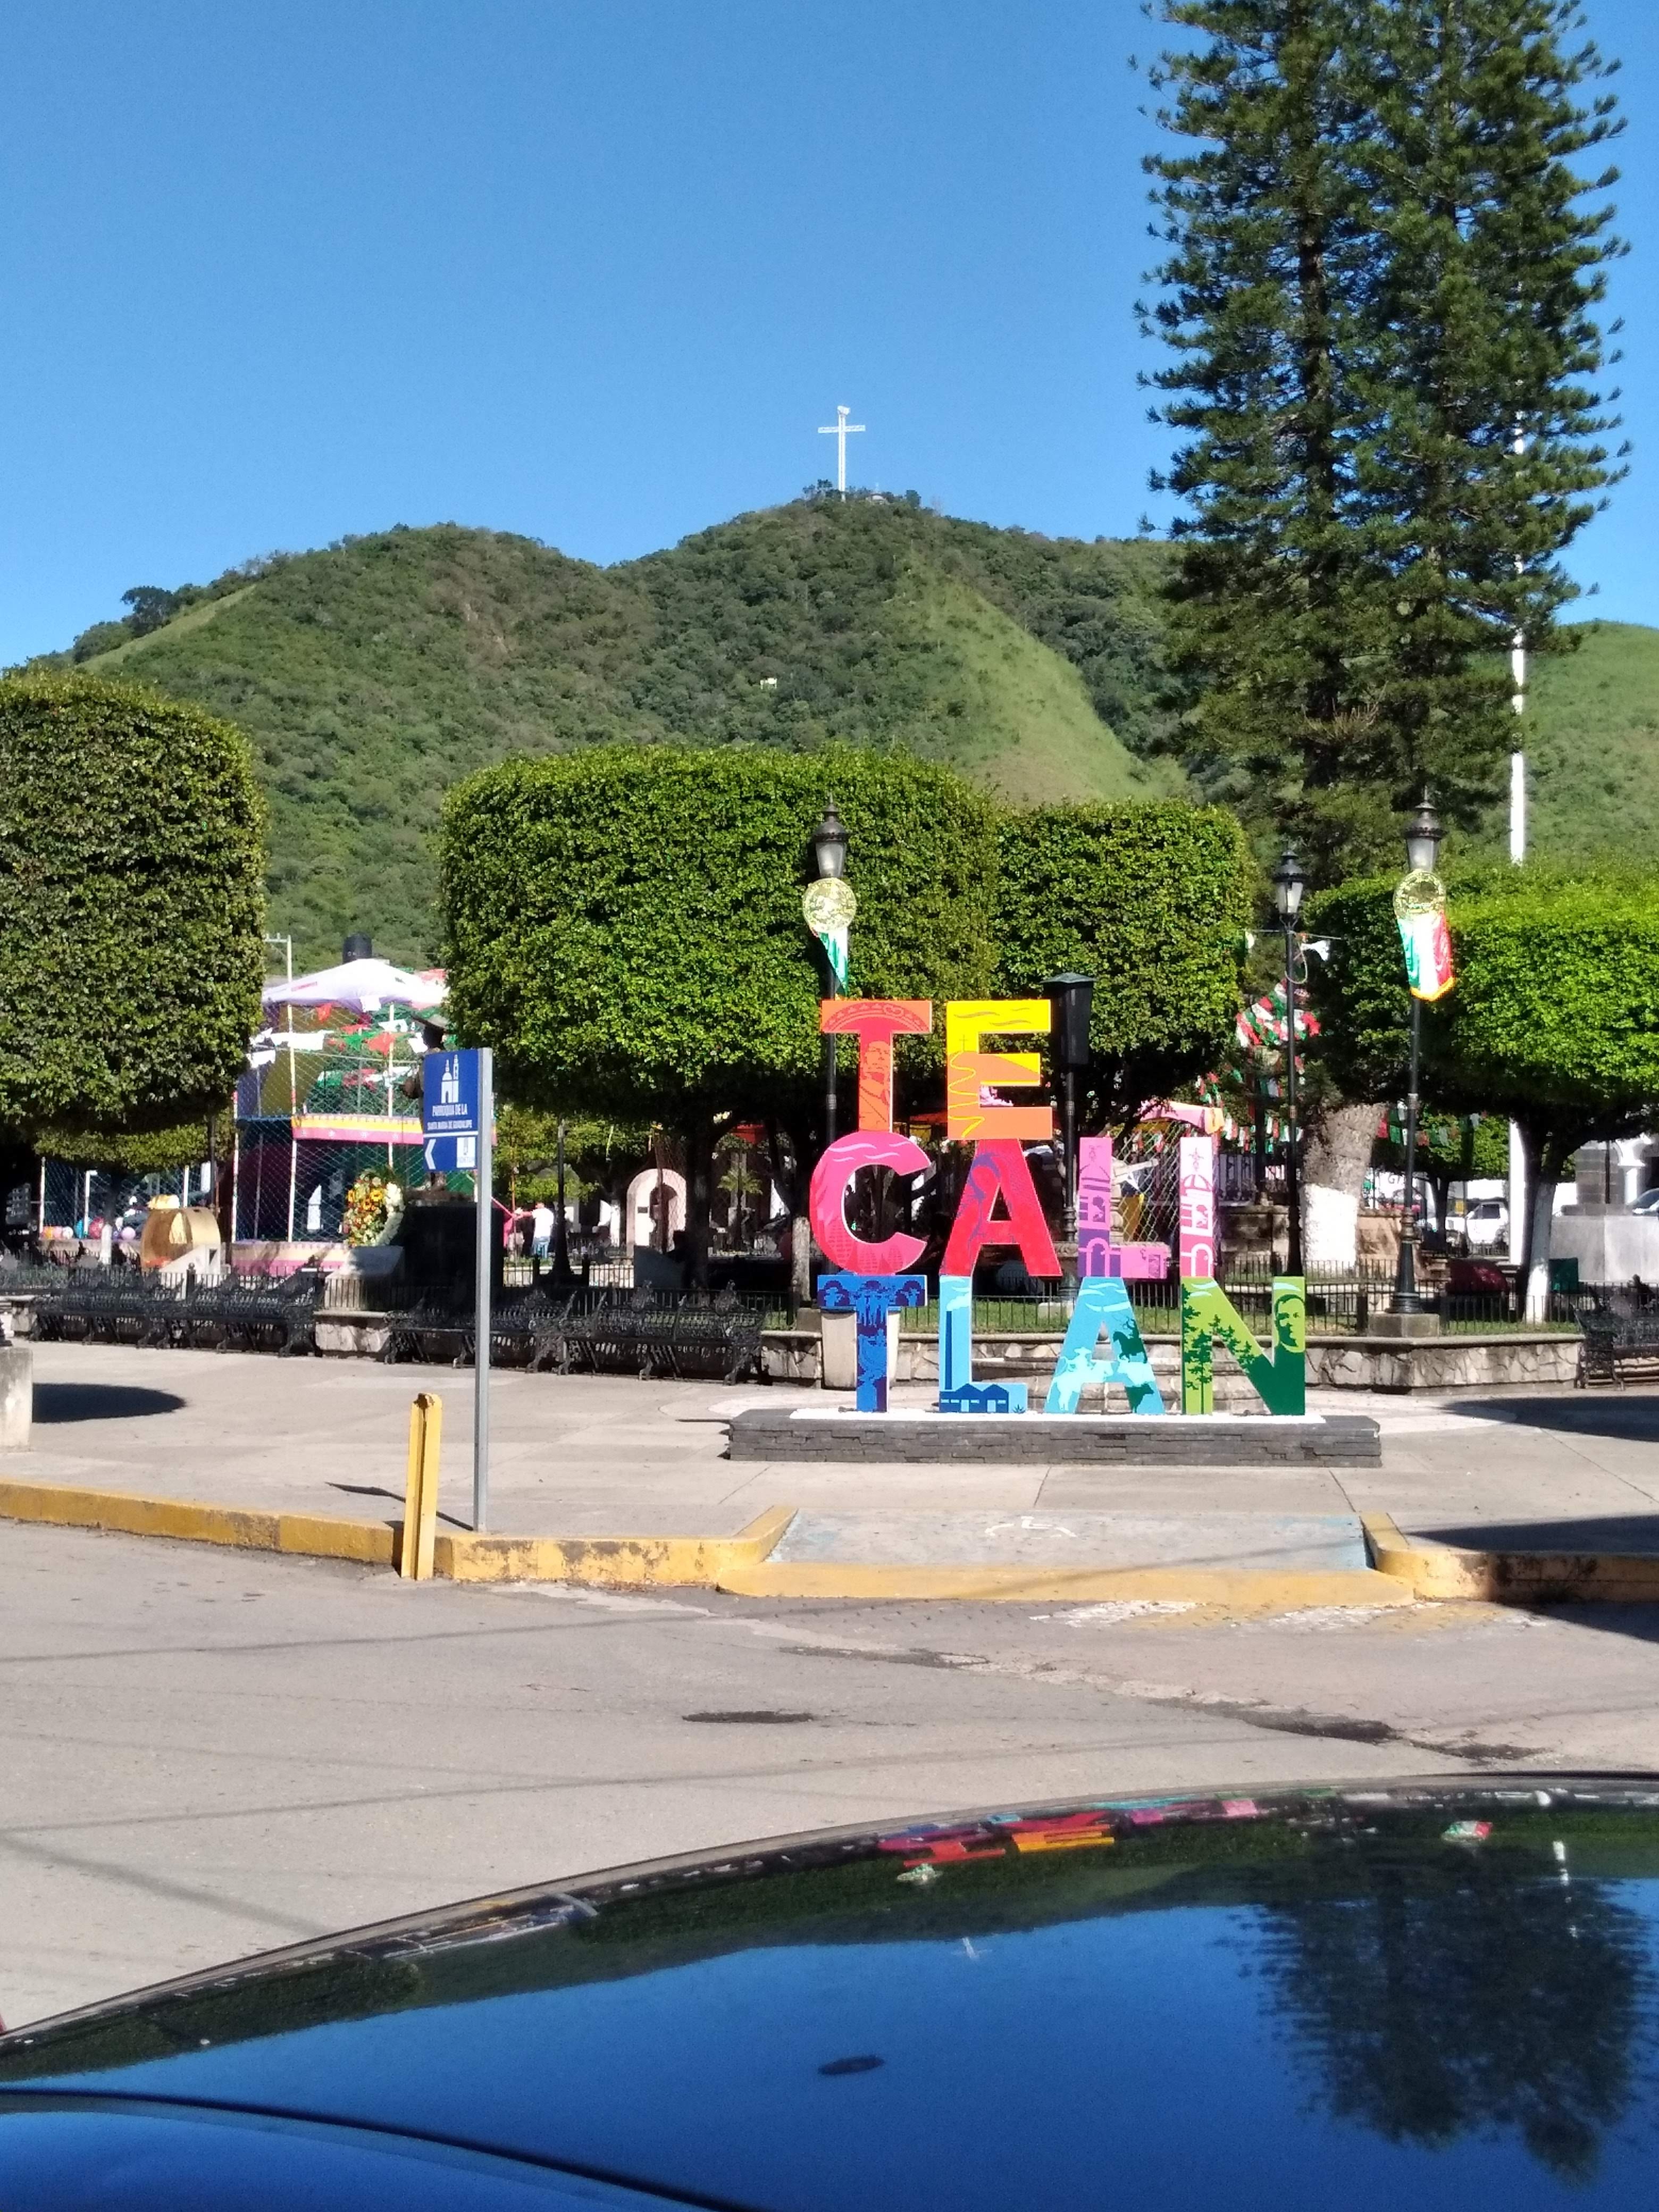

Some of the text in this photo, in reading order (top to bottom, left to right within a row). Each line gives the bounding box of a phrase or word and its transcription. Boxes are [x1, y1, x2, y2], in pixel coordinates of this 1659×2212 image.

[820, 1000, 1052, 1141] TE
[809, 1130, 1214, 1279] CALI
[817, 1275, 1305, 1415] TLAN
